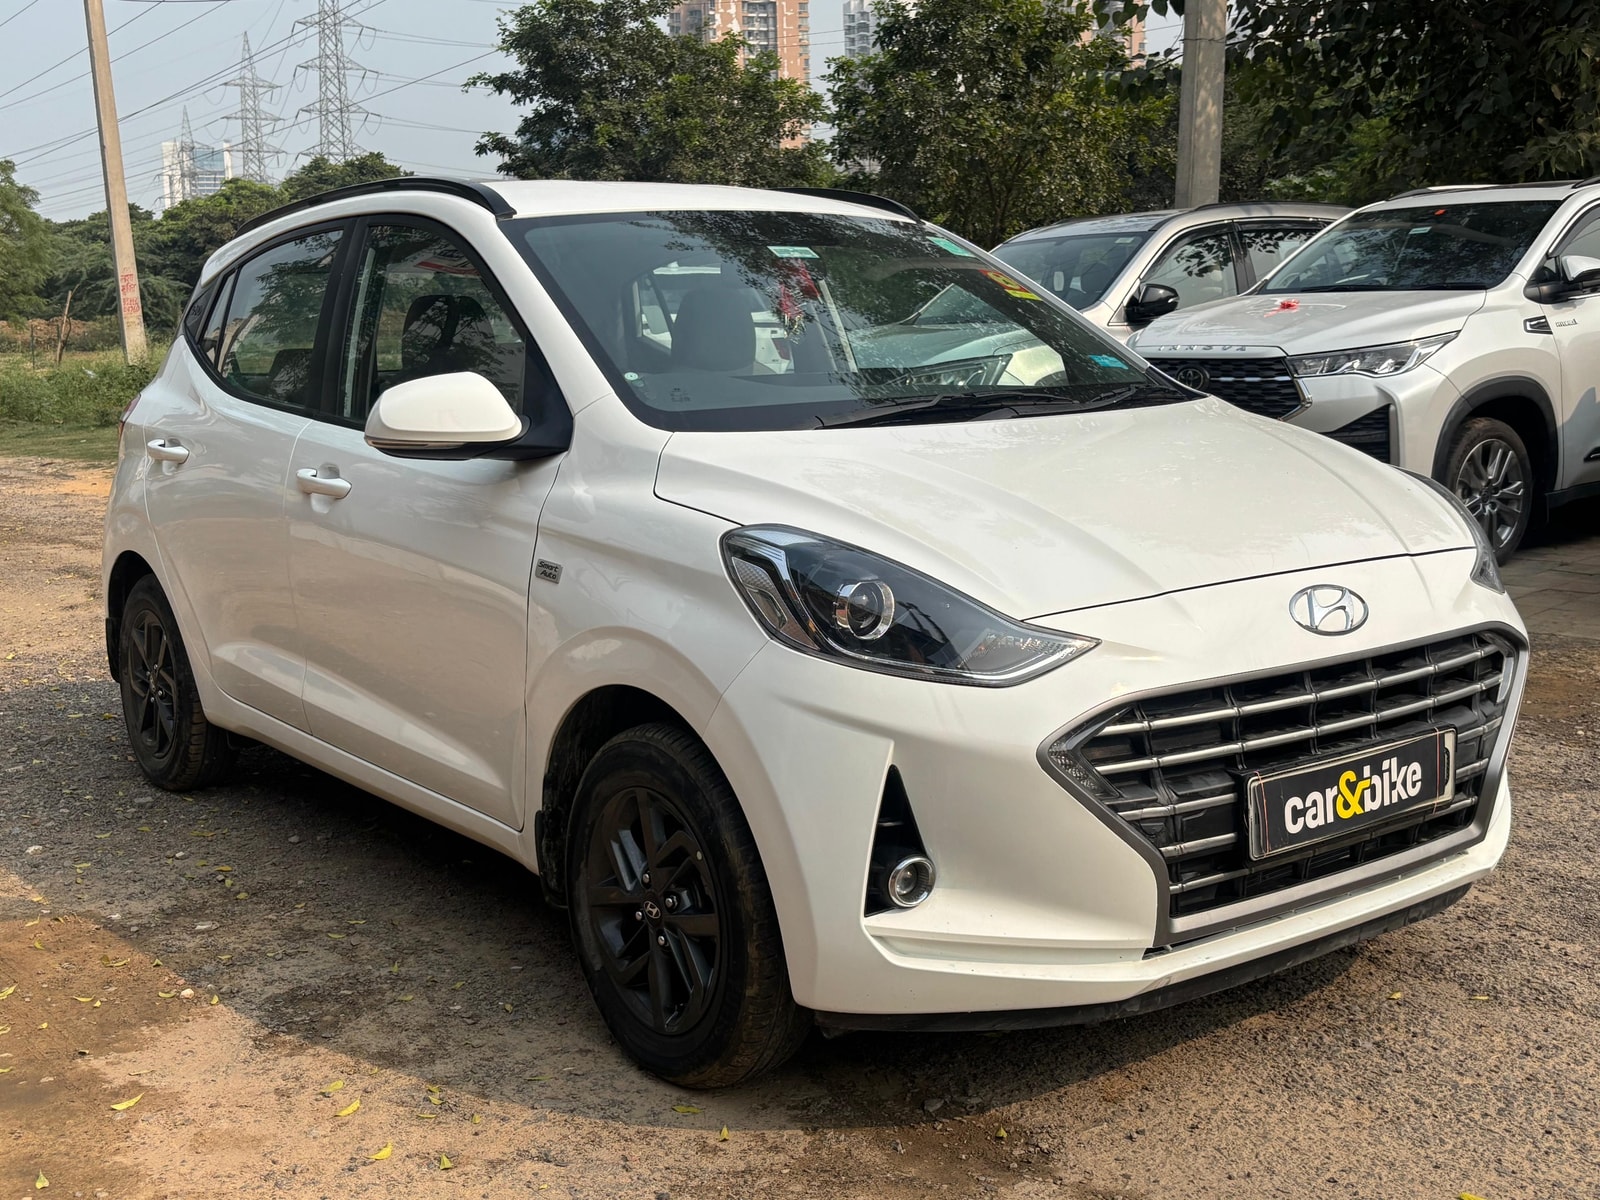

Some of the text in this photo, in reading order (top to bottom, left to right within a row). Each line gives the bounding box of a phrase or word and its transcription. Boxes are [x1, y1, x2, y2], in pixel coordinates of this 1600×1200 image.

[538, 560, 559, 572] Smart
[540, 569, 557, 580] Auto
[1284, 756, 1422, 834] car&bike
